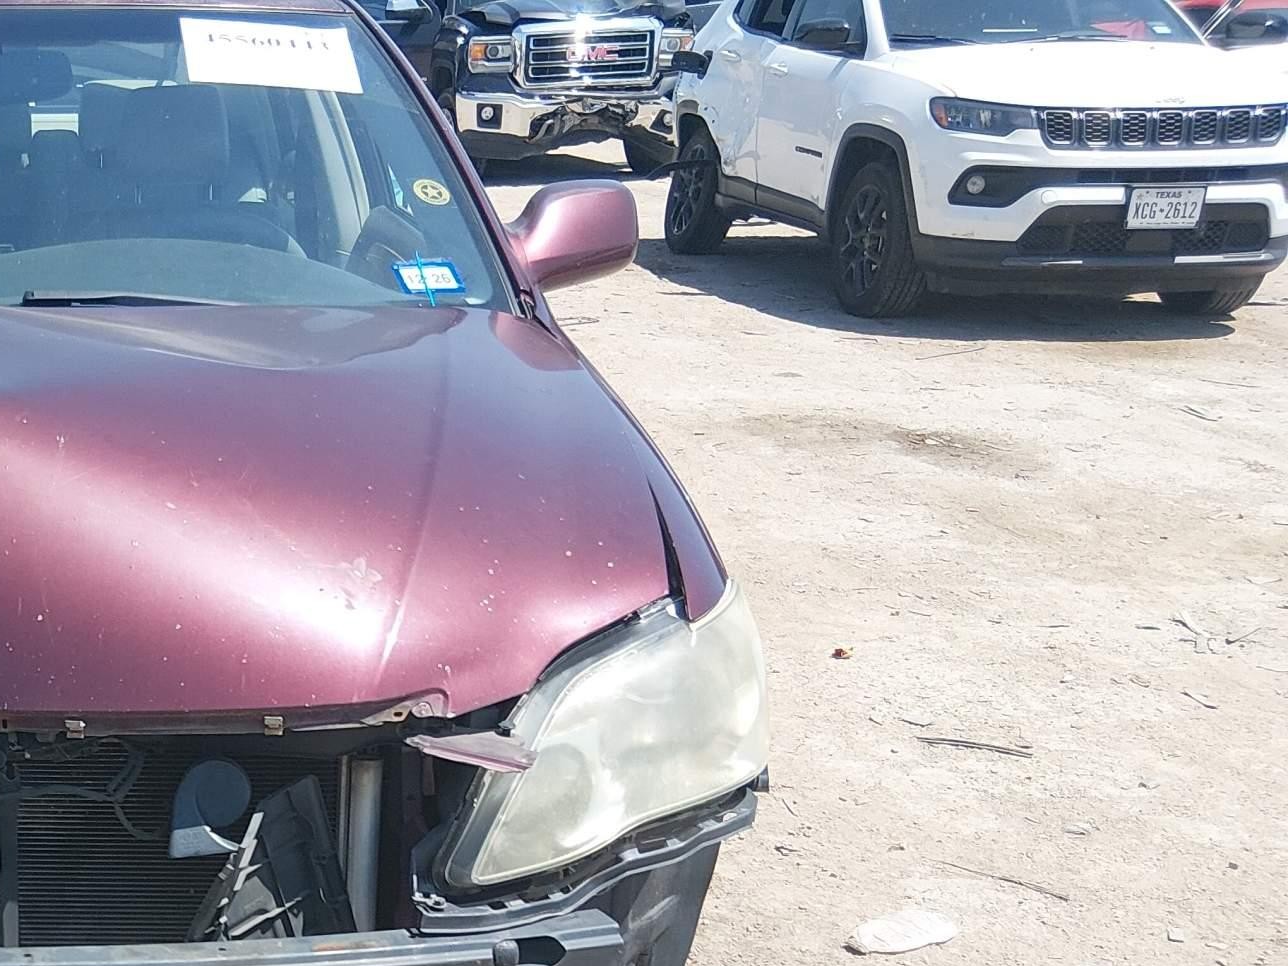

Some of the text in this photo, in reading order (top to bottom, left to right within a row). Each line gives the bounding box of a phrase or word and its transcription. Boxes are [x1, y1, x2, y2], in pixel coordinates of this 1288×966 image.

[566, 44, 620, 62] GMC
[1155, 191, 1183, 199] TEXAS
[1132, 201, 1198, 219] XCG 2612
